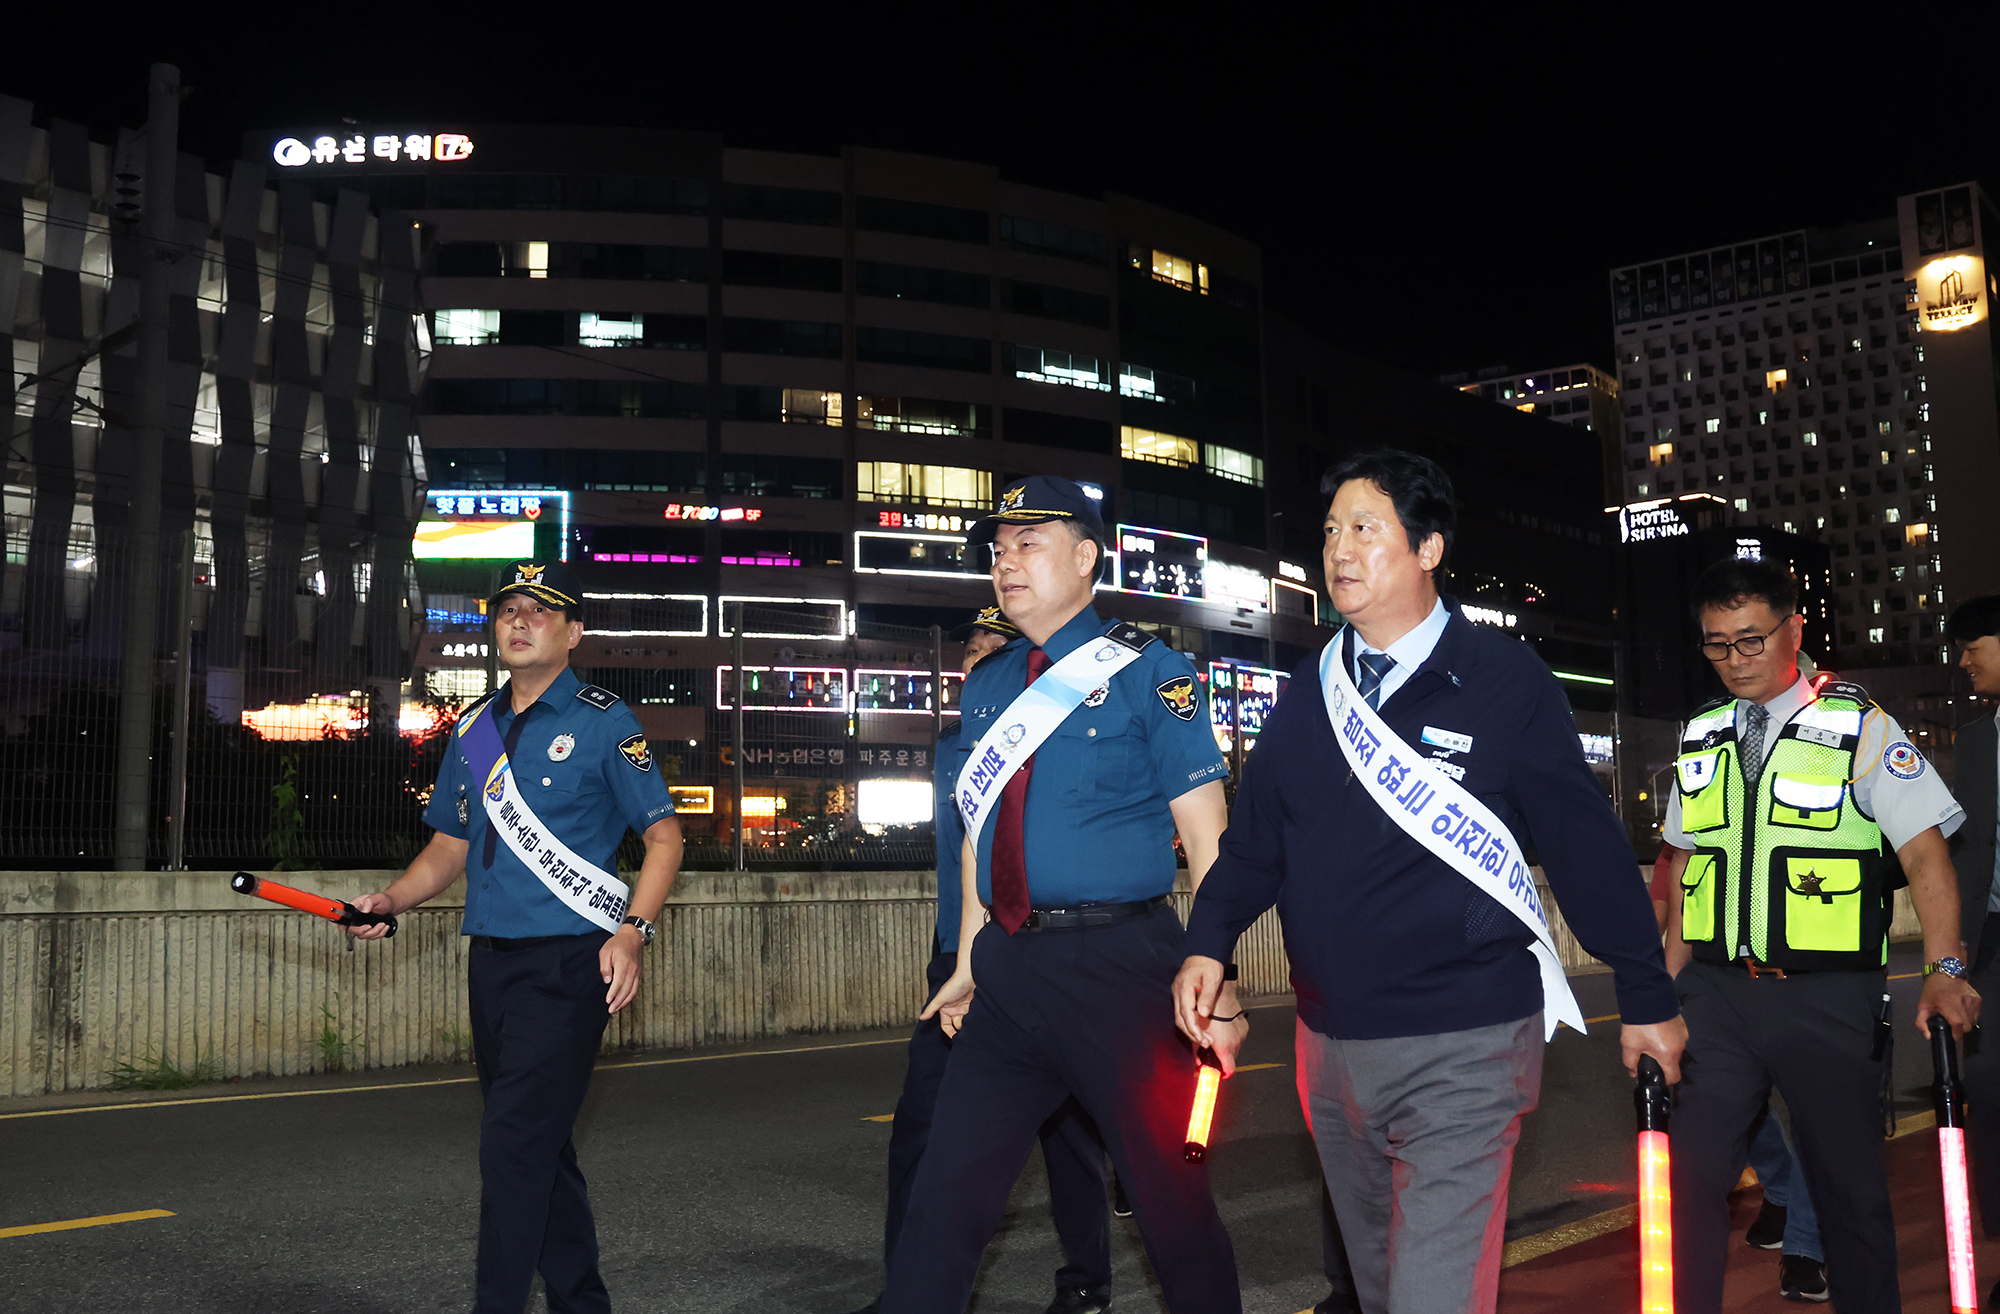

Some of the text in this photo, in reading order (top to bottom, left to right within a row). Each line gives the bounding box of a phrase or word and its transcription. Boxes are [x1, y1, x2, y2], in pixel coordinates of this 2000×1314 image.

[373, 133, 432, 162] 타워
[745, 508, 762, 522] 5F
[1630, 509, 1680, 528] HOTEL
[1177, 704, 1195, 714] POLICE
[858, 748, 927, 766] 파주운정
[968, 744, 1007, 797] 범죄
[1342, 706, 1382, 768] 범죄
[1376, 753, 1437, 817] 없는
[1430, 801, 1510, 879] 안전한
